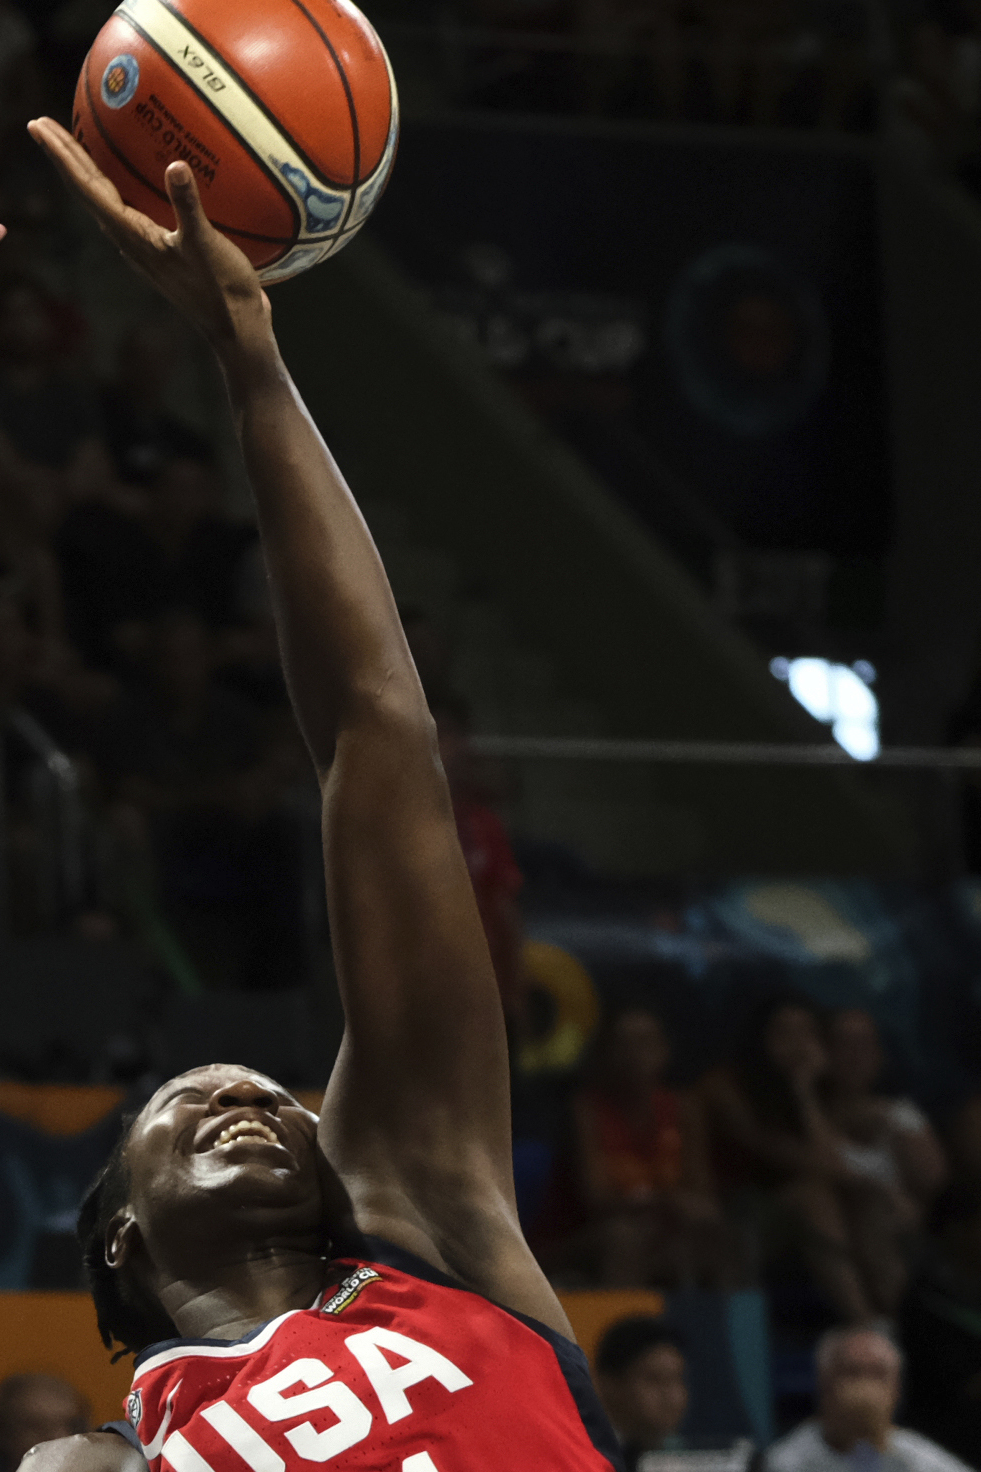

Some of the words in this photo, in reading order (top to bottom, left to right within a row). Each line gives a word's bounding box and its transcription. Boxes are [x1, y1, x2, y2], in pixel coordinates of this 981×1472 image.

[177, 45, 227, 92] GL6X
[135, 102, 163, 131] CUP
[162, 130, 216, 187] WORLD
[325, 1279, 359, 1313] WORLD
